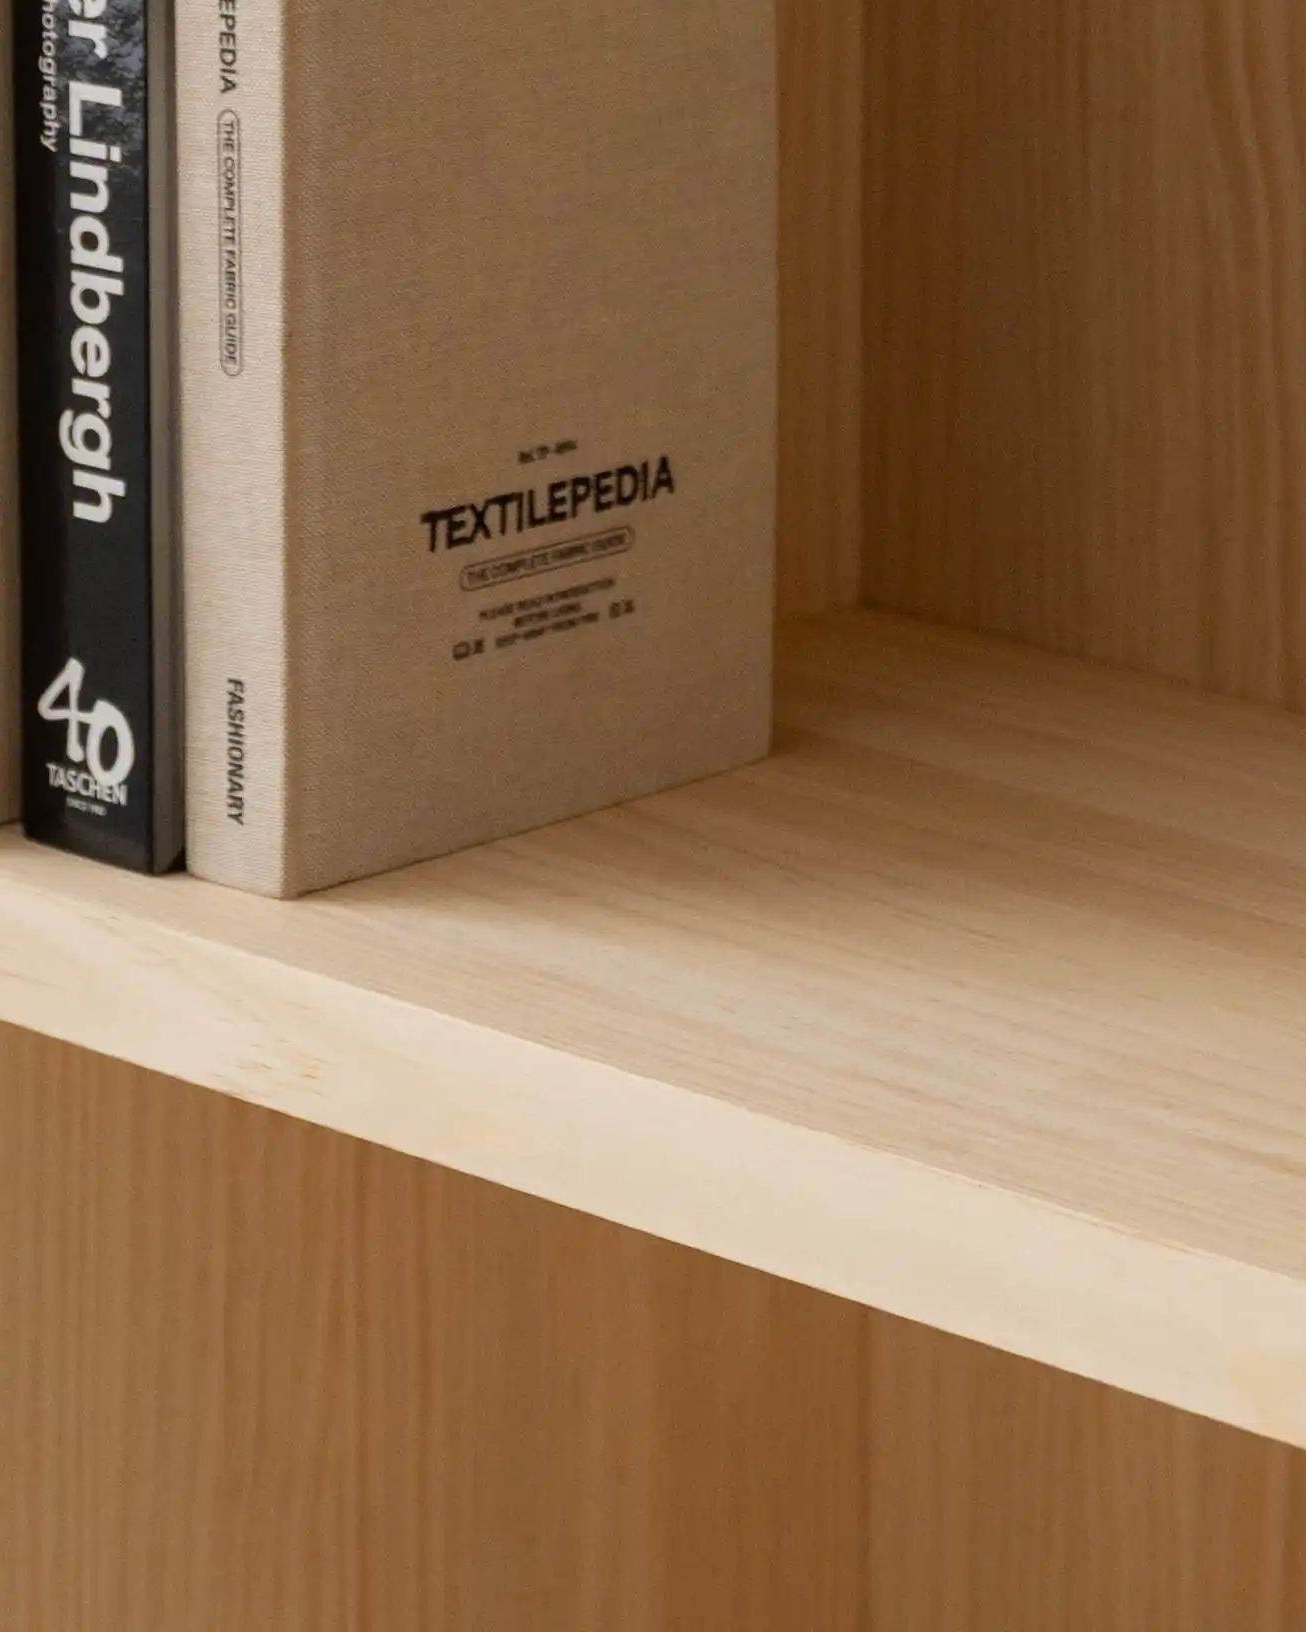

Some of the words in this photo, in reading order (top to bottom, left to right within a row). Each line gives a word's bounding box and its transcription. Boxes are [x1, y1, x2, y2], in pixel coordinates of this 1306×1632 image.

[223, 120, 235, 152] THE
[223, 156, 236, 246] COMPLETE
[59, 80, 126, 524] Lindbergh
[224, 248, 236, 309] FABRIC
[225, 313, 237, 364] GUIDE
[420, 454, 675, 553] TEXTILEPEDIA
[37, 657, 135, 787] 40
[227, 677, 247, 825] FASHIONARY
[46, 762, 128, 806] TASCHEN
